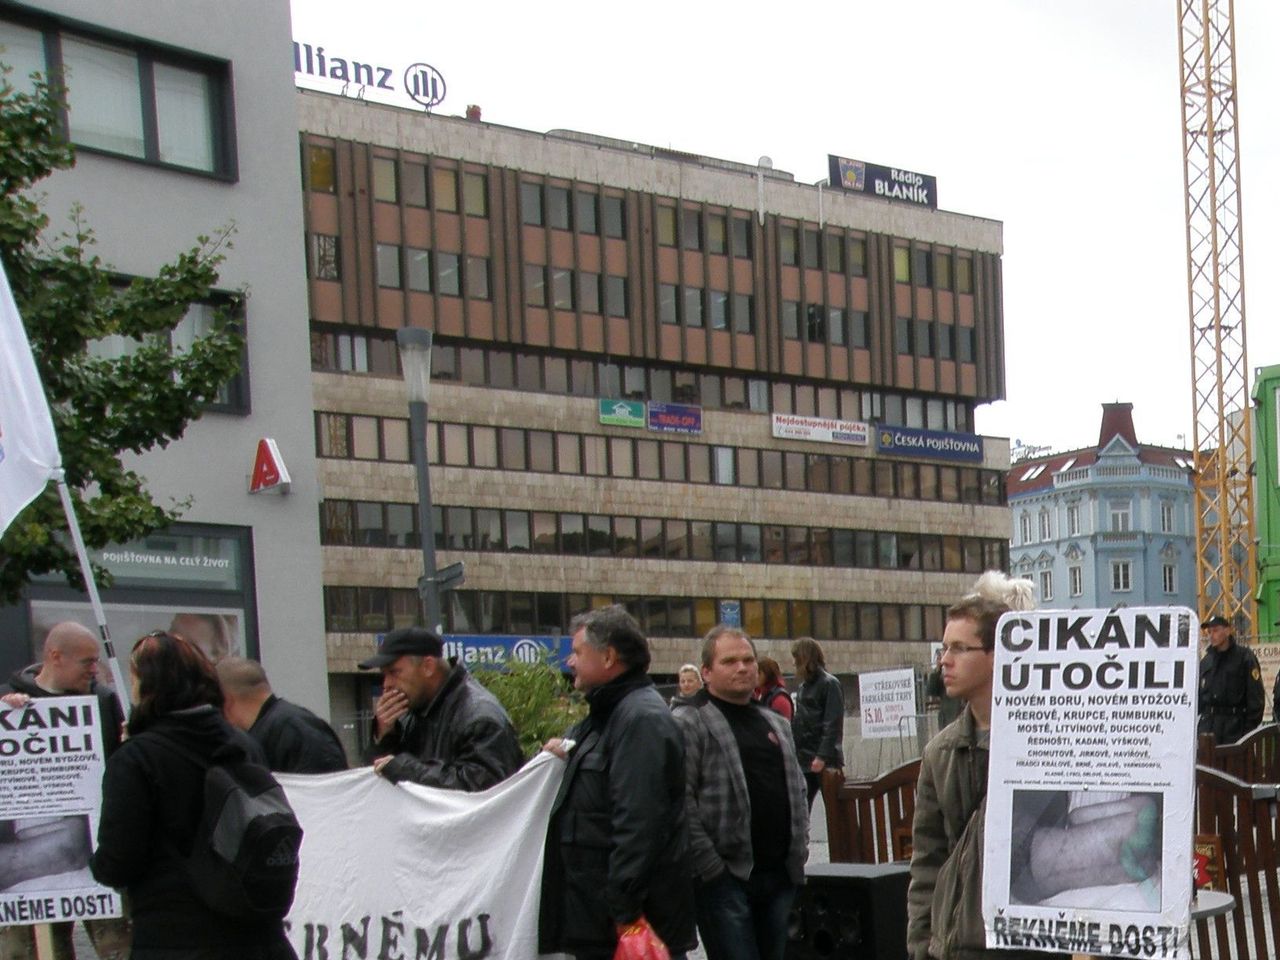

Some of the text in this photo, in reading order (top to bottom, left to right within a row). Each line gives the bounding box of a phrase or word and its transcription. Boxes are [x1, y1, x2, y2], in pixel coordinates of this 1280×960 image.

[874, 178, 928, 204] BLANÍK
[894, 433, 980, 453] ČESKÁ POJIŠŤOVNA
[102, 550, 229, 569] POJIŠŤOVNA NA CELÝ ŽIVOT
[1000, 608, 1191, 652] CIKÁNI
[1002, 654, 1186, 692] ÚTOČILI
[994, 696, 1002, 707] V
[1005, 695, 1046, 707] NOVÉM
[1048, 696, 1086, 708] BORU,
[1087, 694, 1129, 706] NOVÉM
[1063, 711, 1109, 722] KRUPCE,
[1111, 711, 1176, 722] RUMBURKU,
[0, 732, 93, 758] OČILI
[0, 894, 115, 923] NĚME DOST!
[993, 908, 1101, 951] ŘEKNĚME
